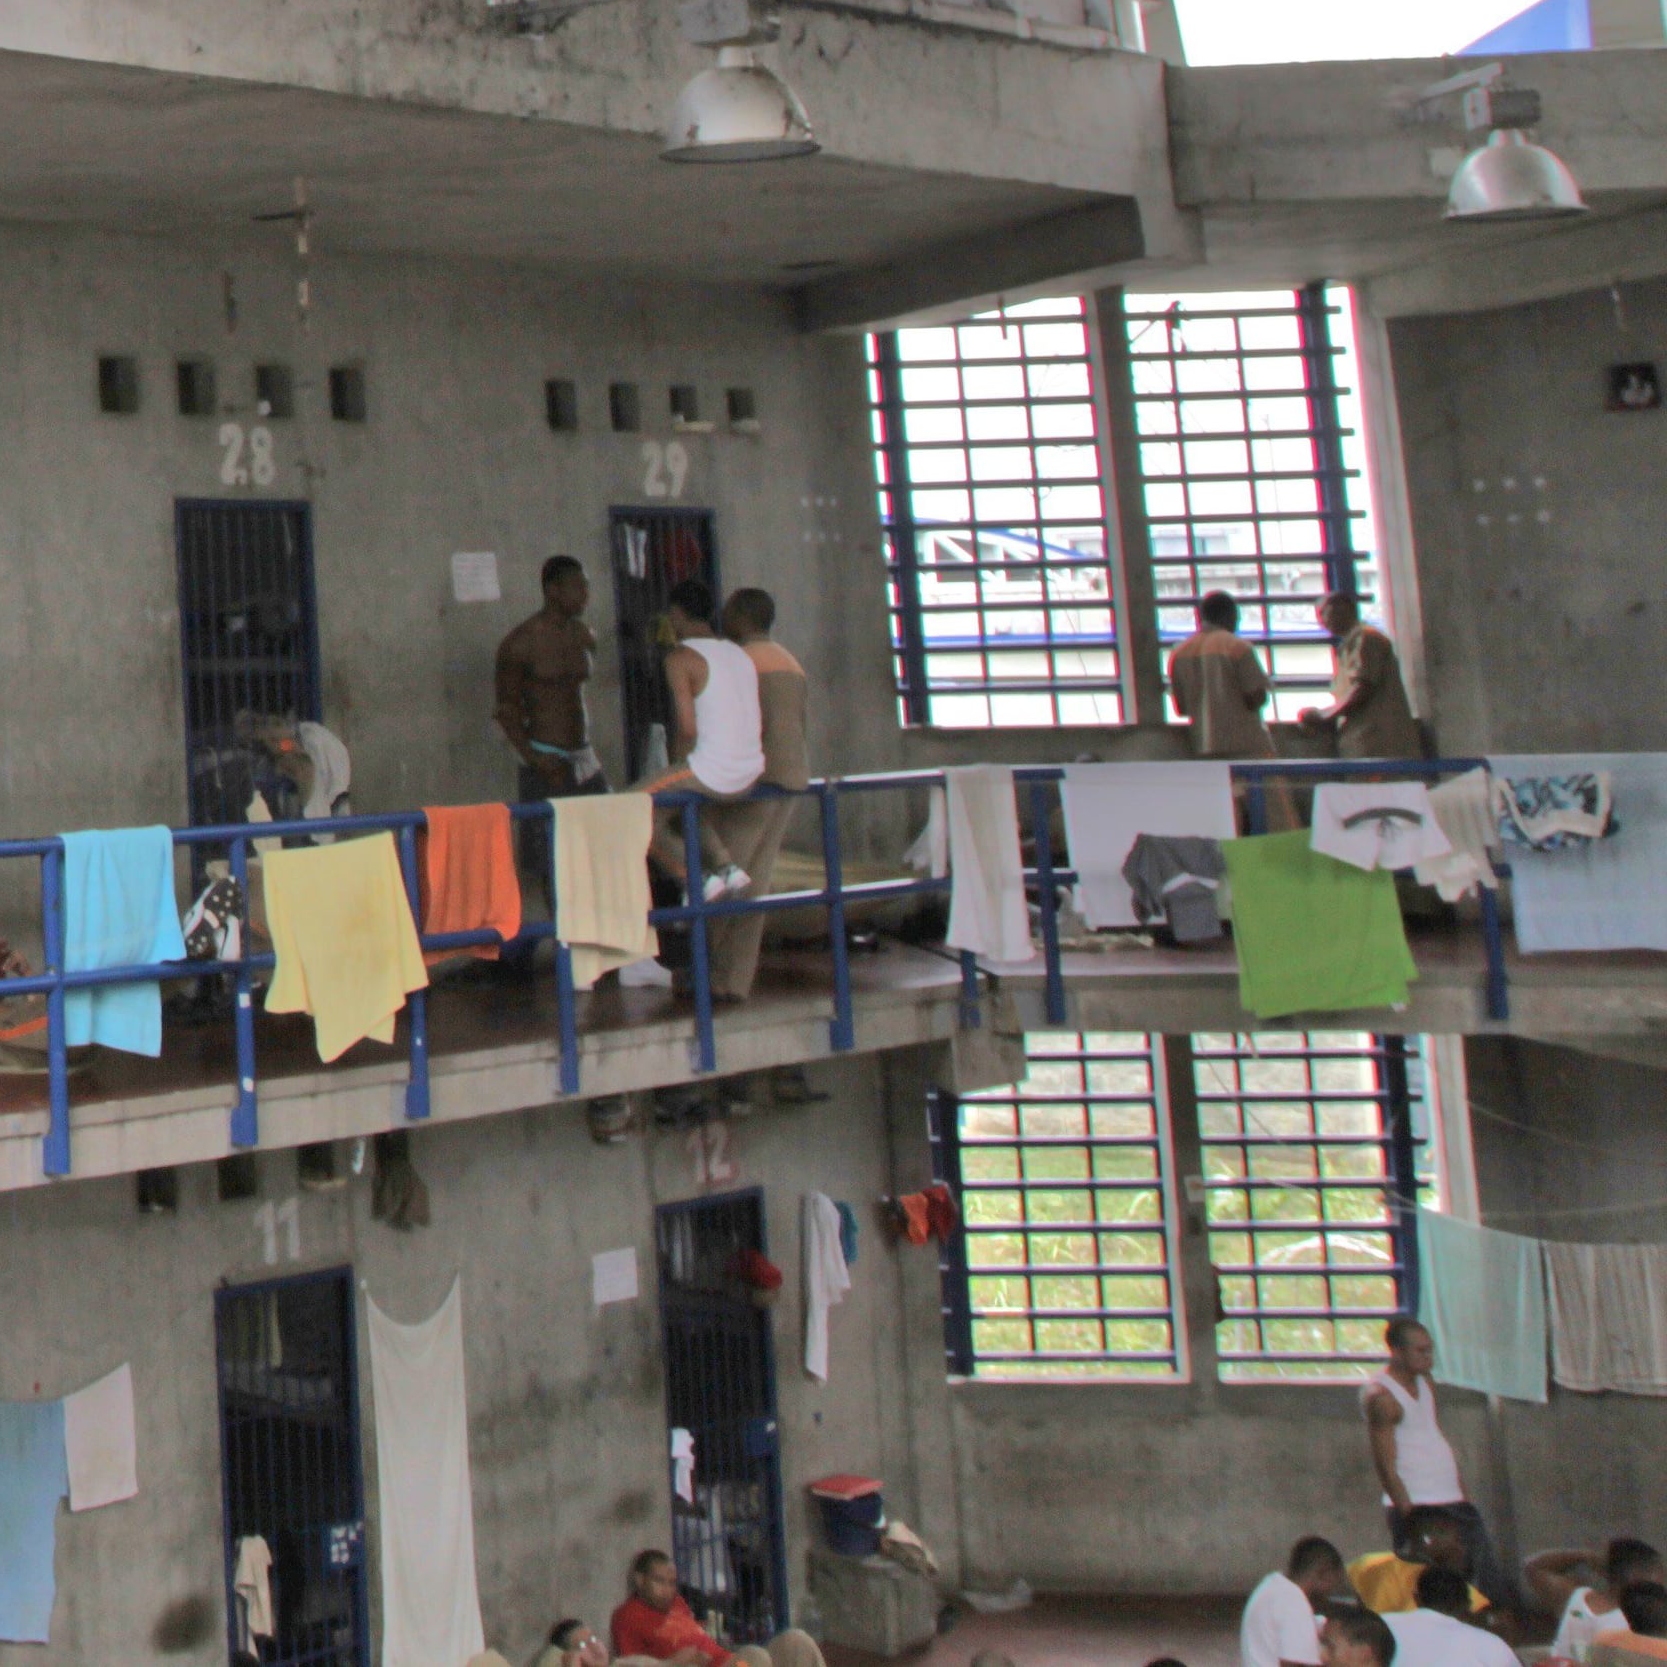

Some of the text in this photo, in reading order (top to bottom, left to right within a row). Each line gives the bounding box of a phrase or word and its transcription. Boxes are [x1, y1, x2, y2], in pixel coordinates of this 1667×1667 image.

[219, 424, 275, 486] 28
[642, 441, 689, 497] 29
[686, 1121, 737, 1184] 12
[255, 1196, 301, 1265] 11
